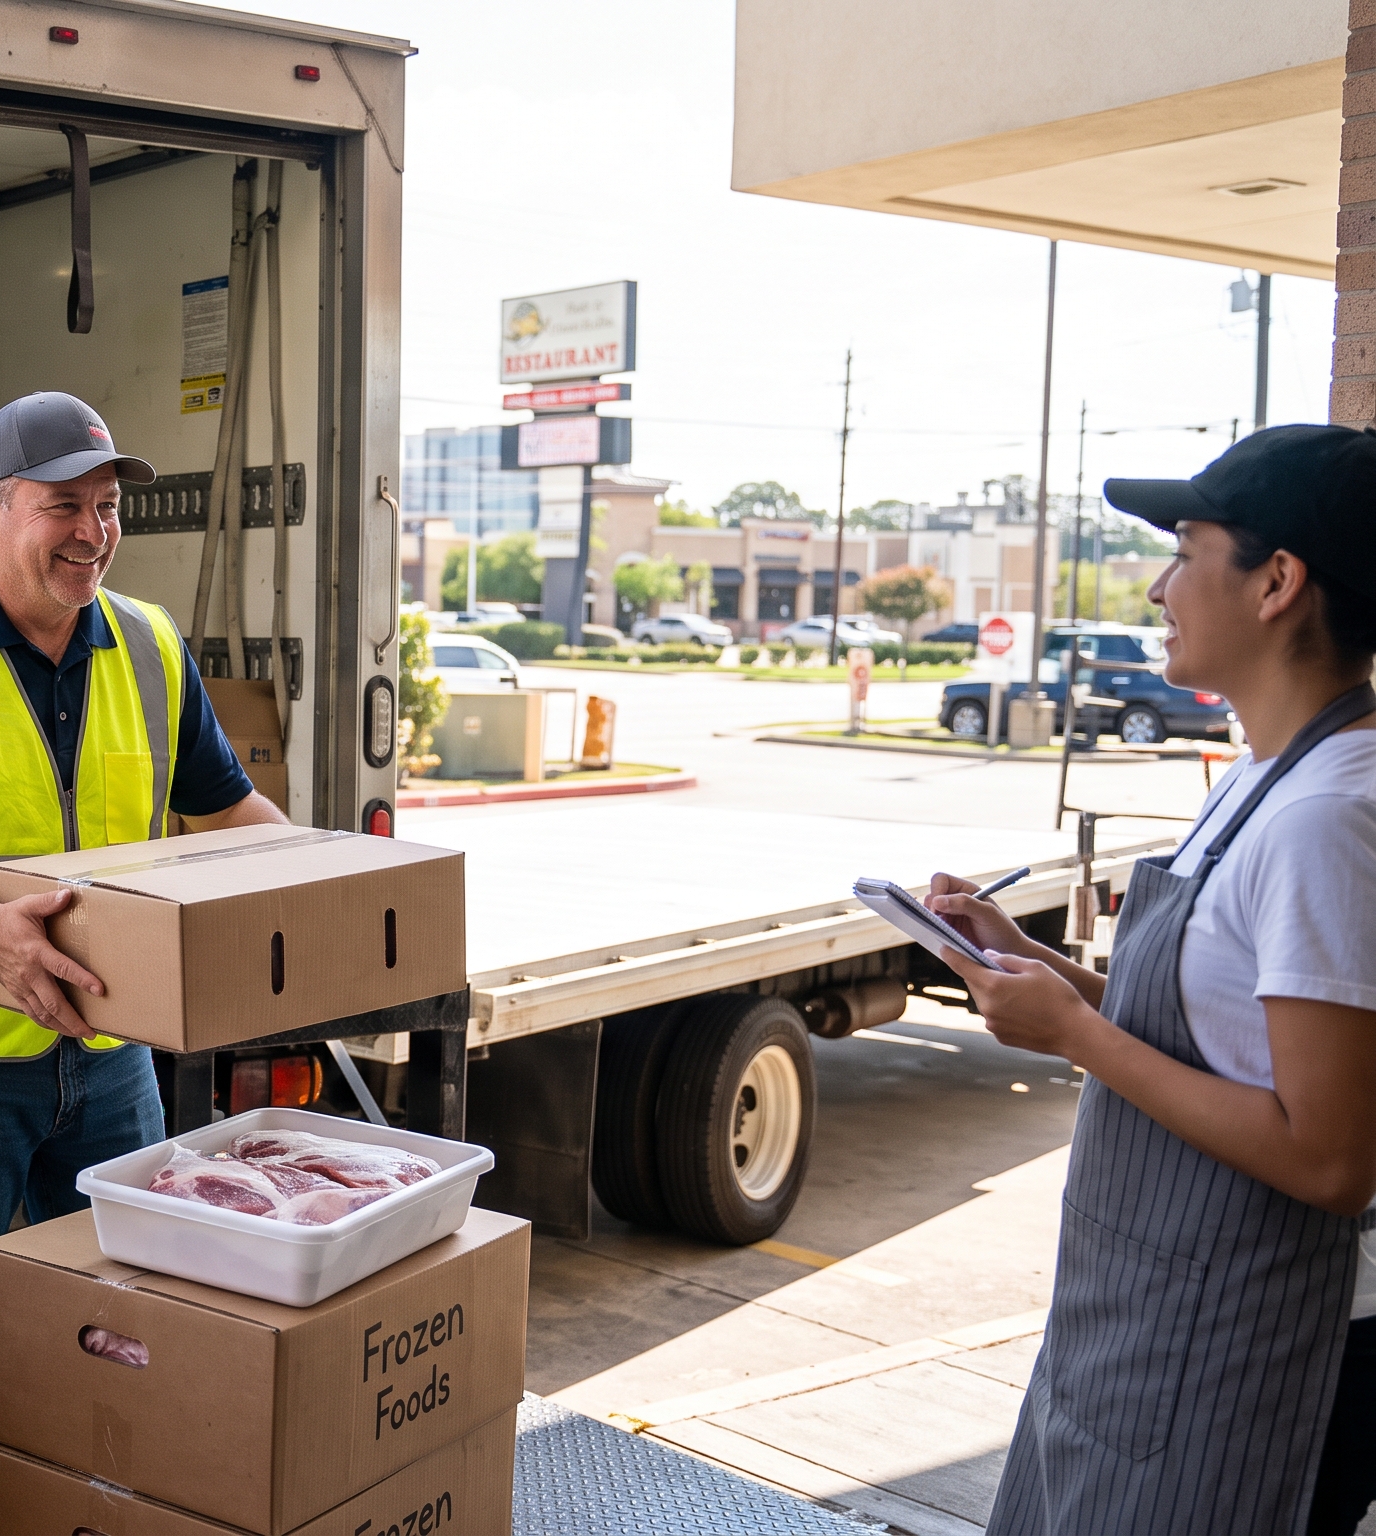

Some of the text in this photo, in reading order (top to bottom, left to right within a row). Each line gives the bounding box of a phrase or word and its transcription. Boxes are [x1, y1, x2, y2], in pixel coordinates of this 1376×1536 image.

[505, 343, 618, 374] RESTAURANT
[363, 1303, 464, 1383] Frozen
[376, 1364, 450, 1440] Foods
[354, 1491, 452, 1536] zen
